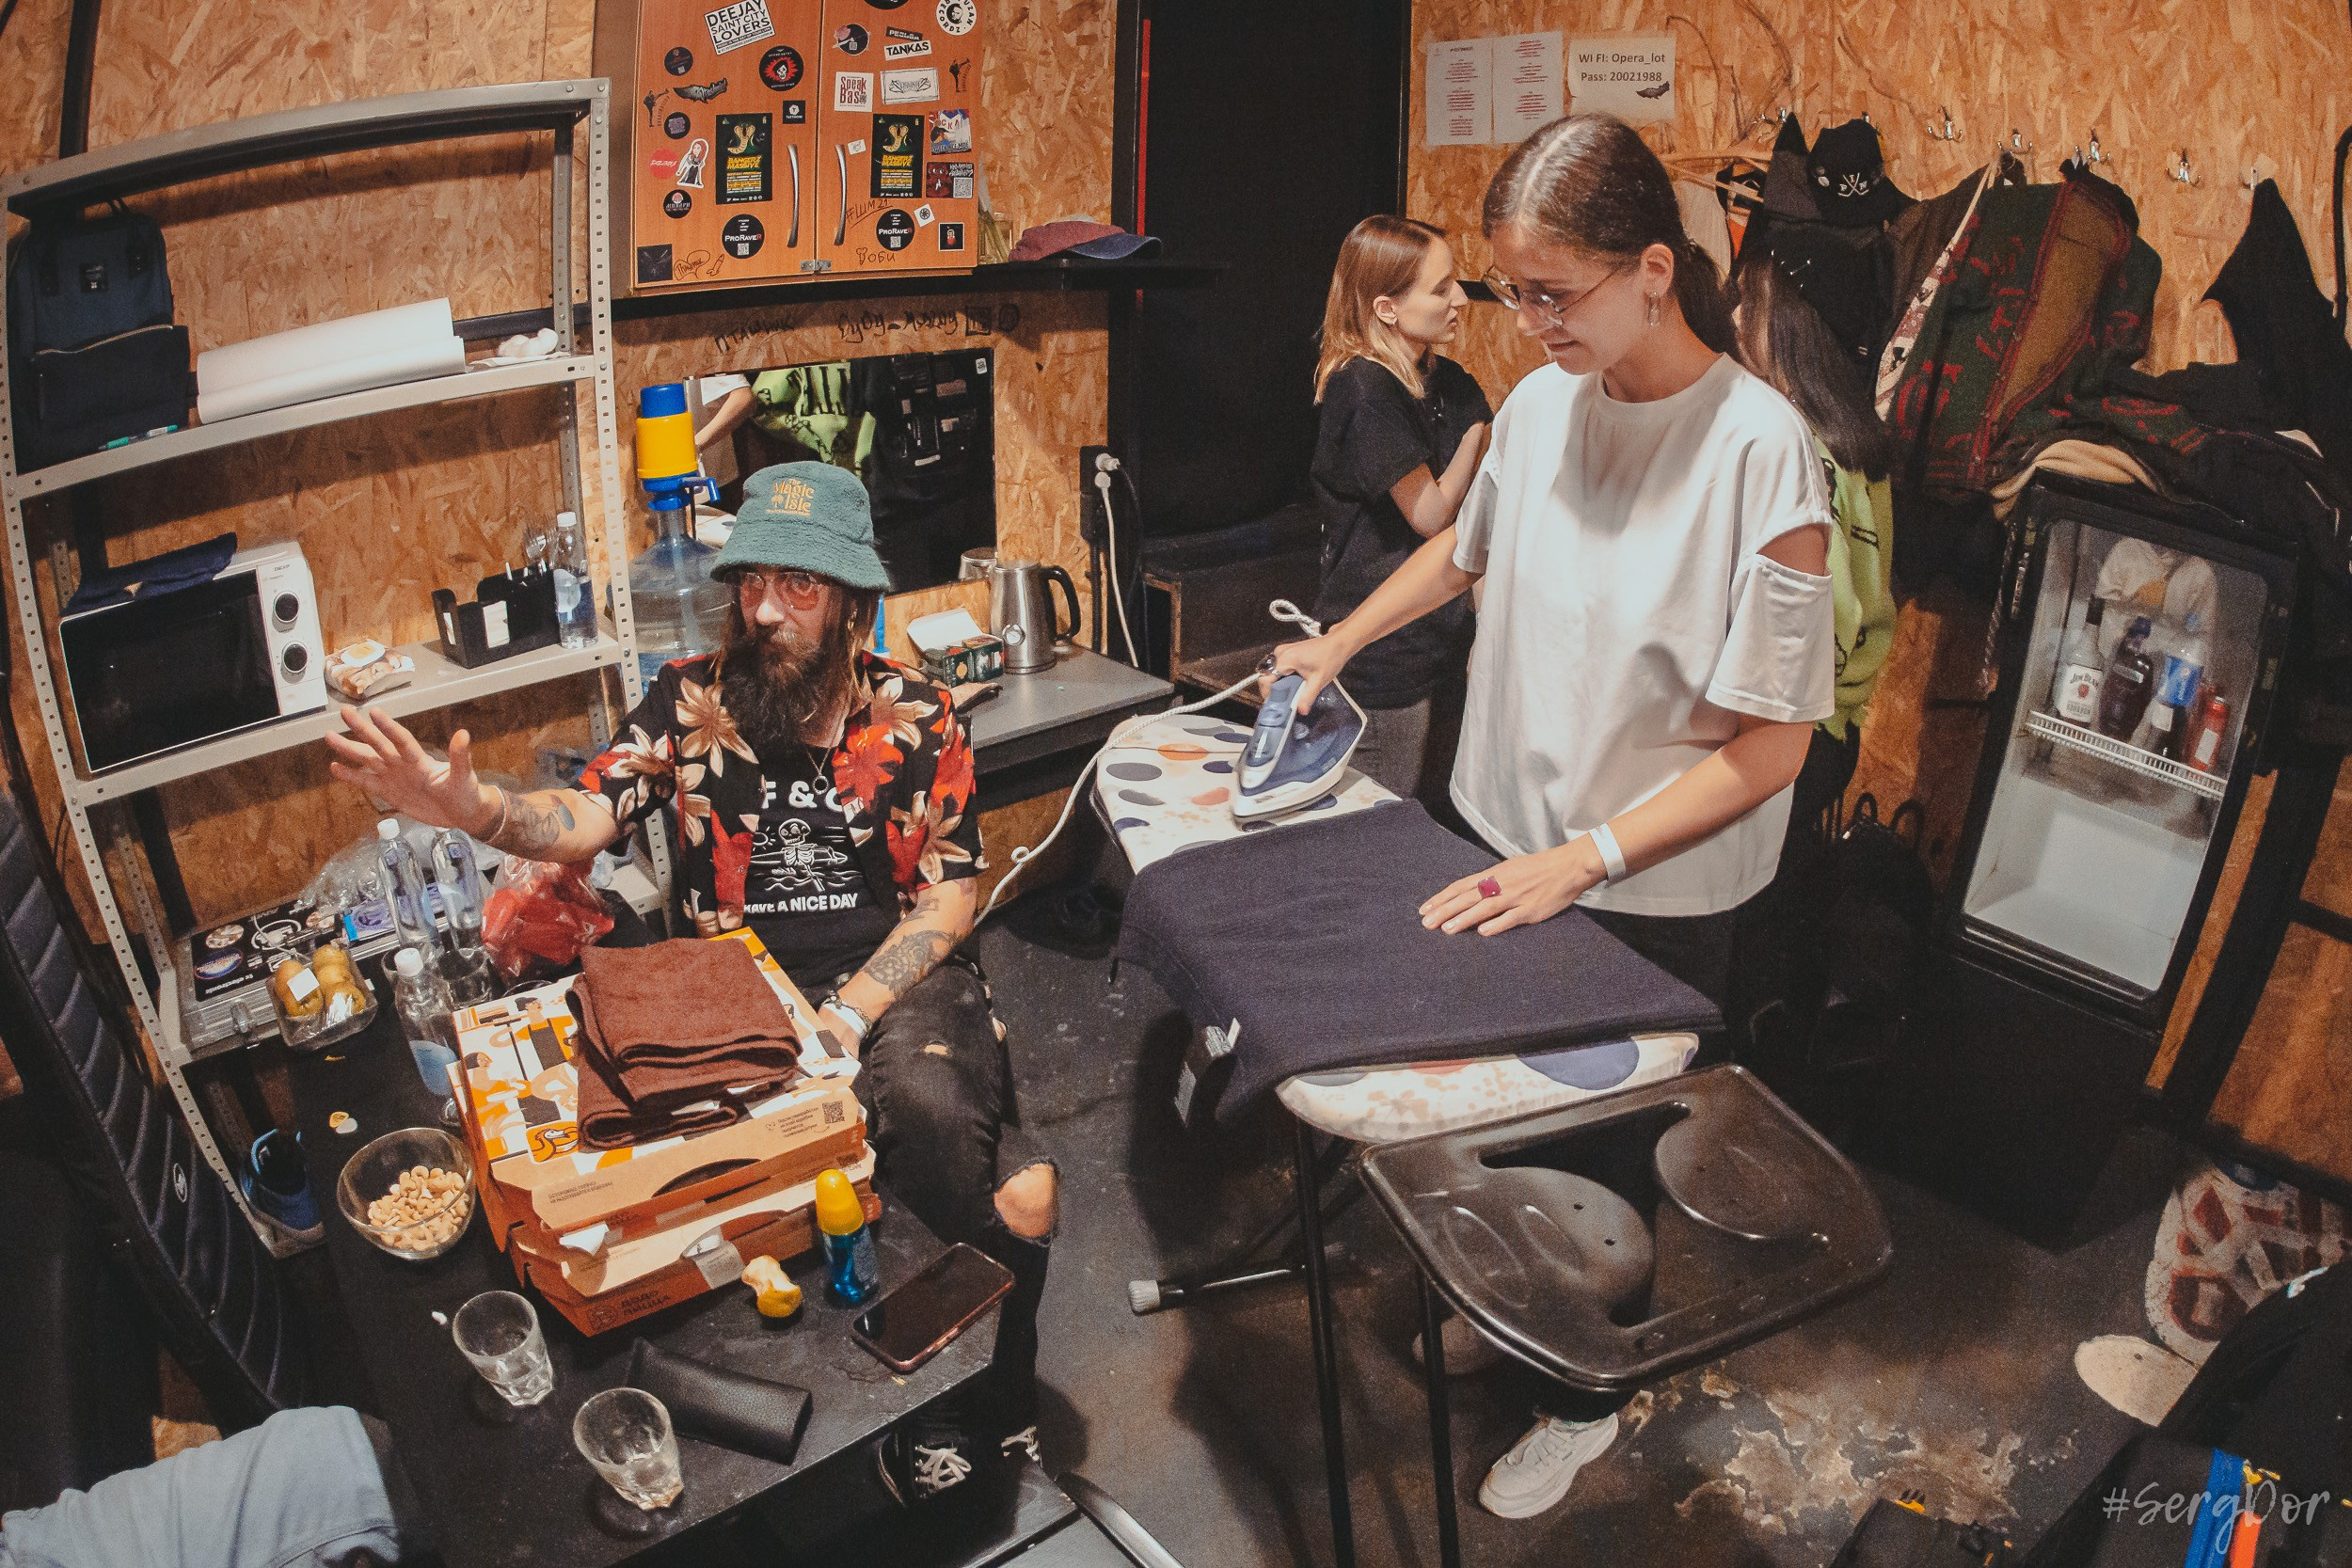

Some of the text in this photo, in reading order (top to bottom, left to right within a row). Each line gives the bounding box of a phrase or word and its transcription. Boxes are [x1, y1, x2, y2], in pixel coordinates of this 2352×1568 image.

[707, 0, 762, 27] DEEJAY
[711, 9, 766, 35] SAINT CITY
[712, 18, 771, 43] LOVERS
[886, 41, 930, 56] TANKAS
[1579, 53, 1665, 65] WI FI: Opera_lot
[840, 76, 867, 91] Speak
[1581, 71, 1662, 82] Pass: 20021988
[840, 85, 867, 104] Bas
[774, 480, 815, 499] Magic
[785, 494, 812, 512] Isle
[788, 781, 818, 808] &
[777, 900, 789, 912] A
[790, 895, 828, 911] NICE
[829, 893, 858, 909] DAY
